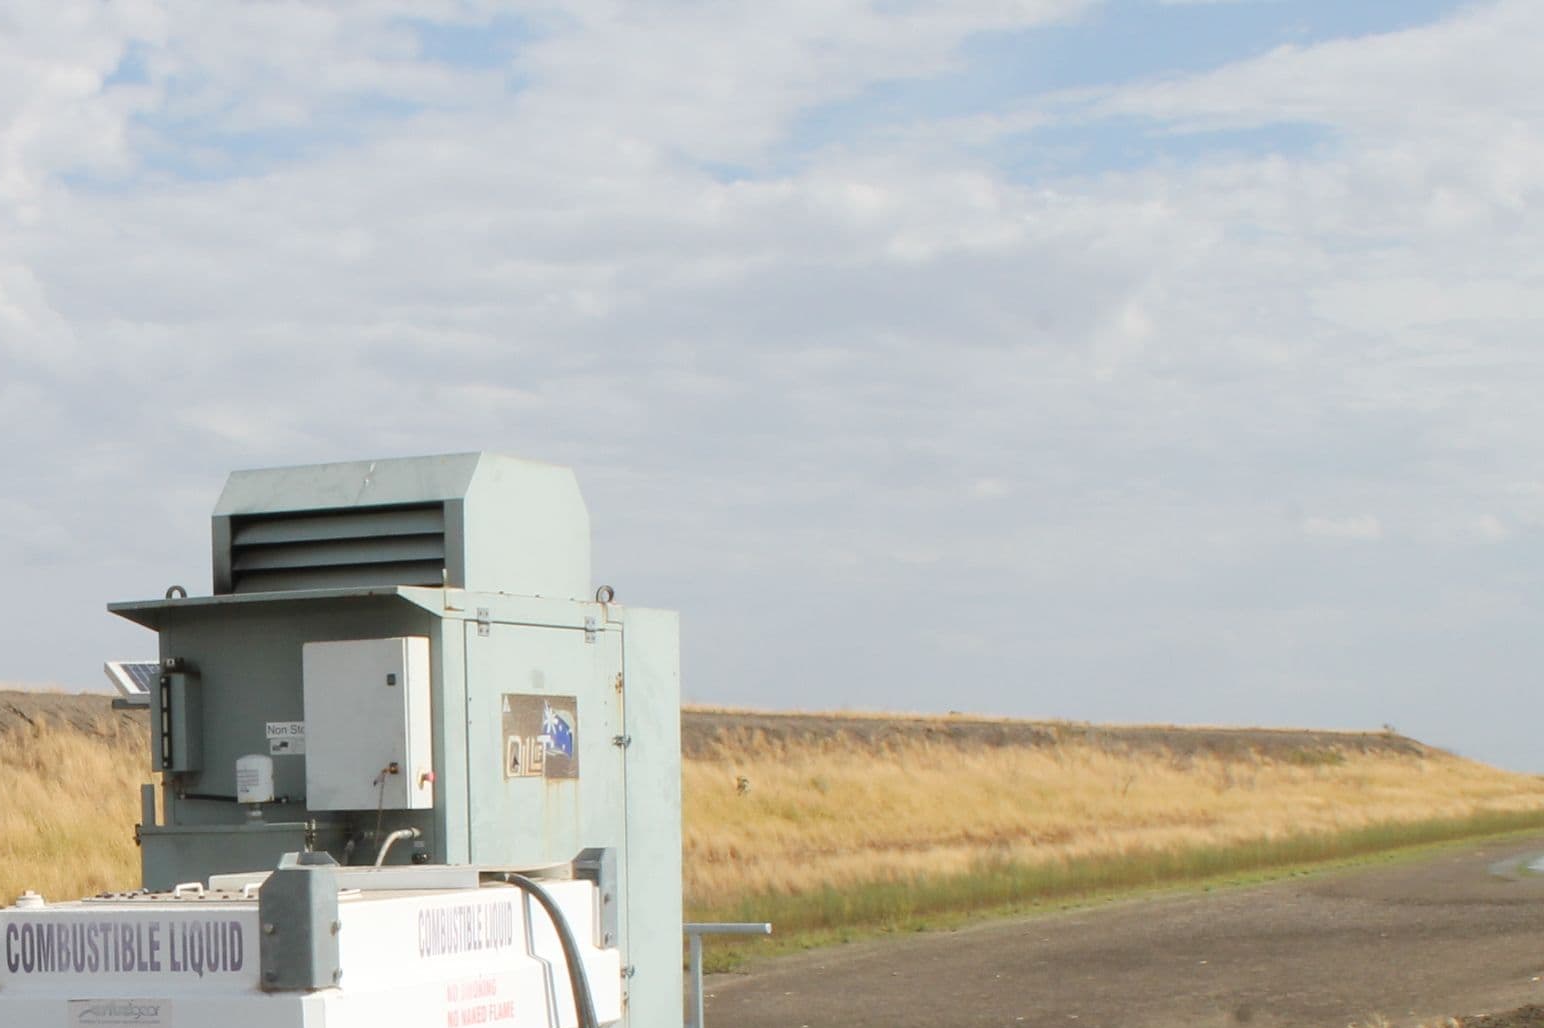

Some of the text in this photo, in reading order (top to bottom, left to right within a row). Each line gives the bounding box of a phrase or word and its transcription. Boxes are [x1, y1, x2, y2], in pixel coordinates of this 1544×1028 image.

[267, 725, 287, 735] Non
[5, 919, 244, 978] COMBUSTIBLE LIQUID
[418, 901, 513, 958] COMBUSTIBLE LIQUID
[461, 1005, 487, 1026] NAKED
